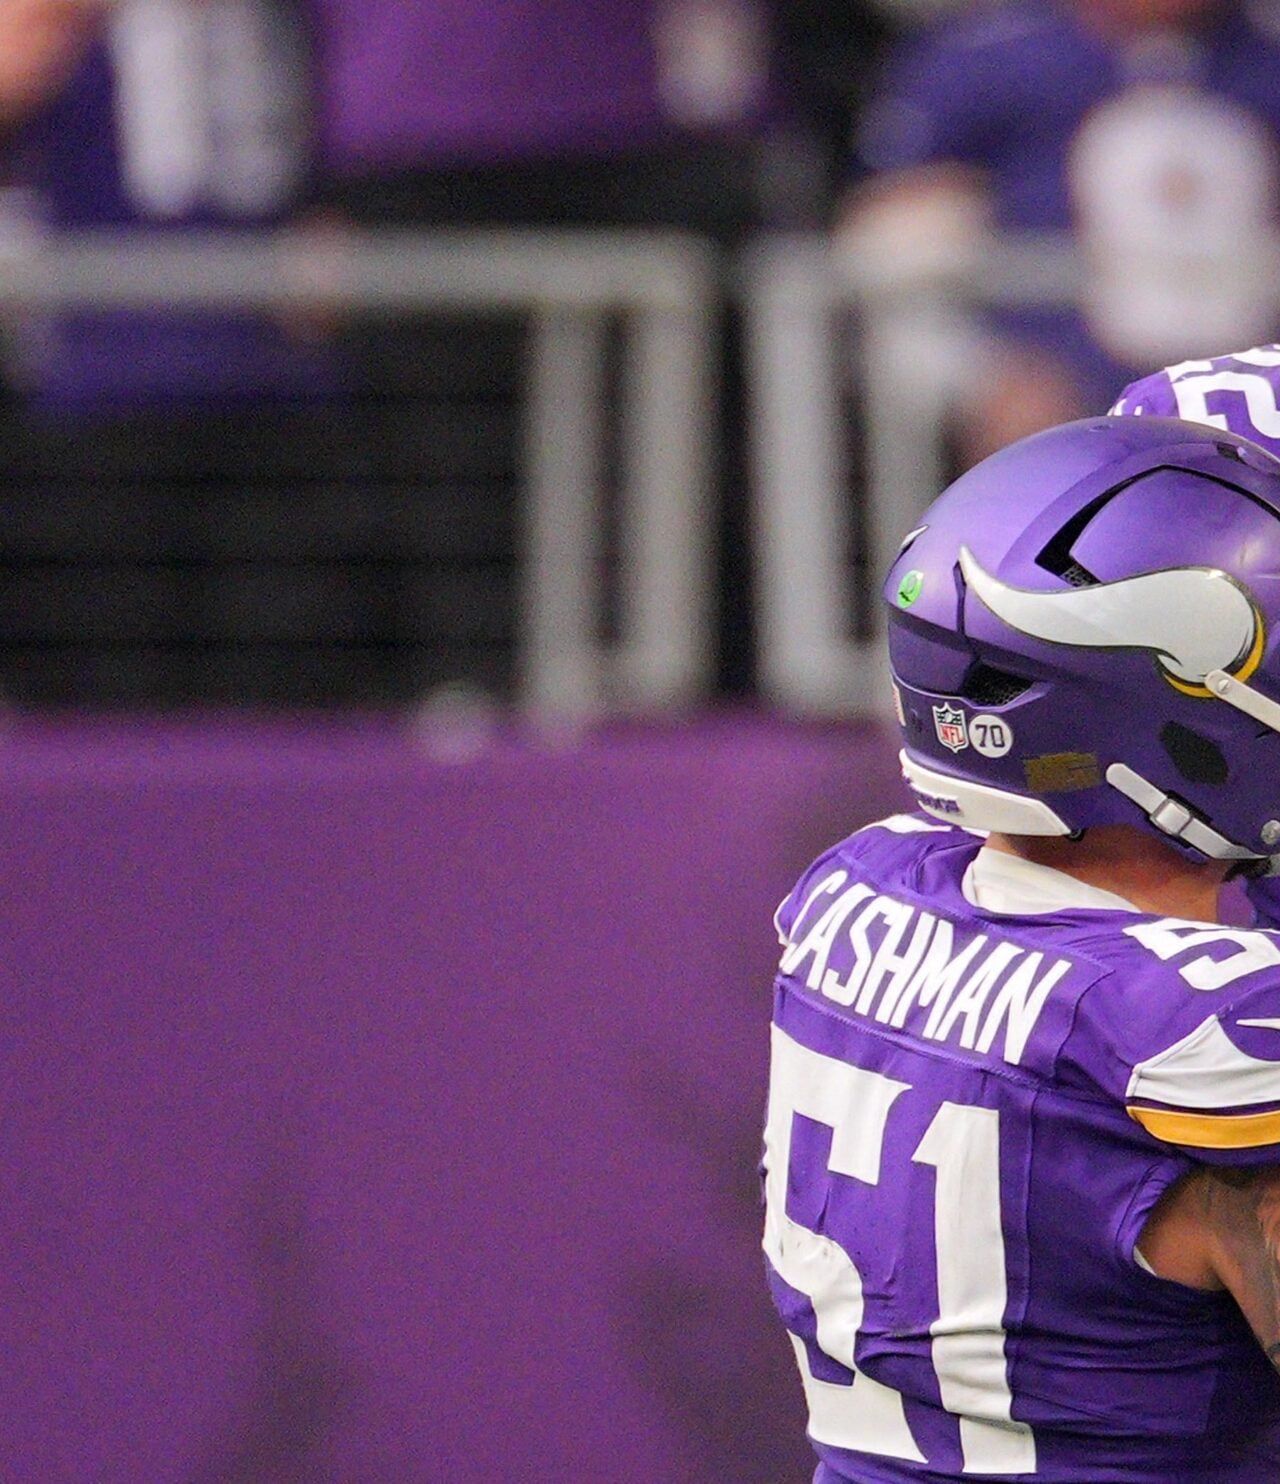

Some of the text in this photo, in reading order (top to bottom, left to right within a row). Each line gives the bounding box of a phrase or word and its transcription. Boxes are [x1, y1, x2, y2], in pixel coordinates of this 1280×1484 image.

[941, 724, 965, 746] NFL
[974, 724, 1006, 748] 70
[778, 869, 1072, 1066] CASHMAN
[762, 1021, 1037, 1474] 51
